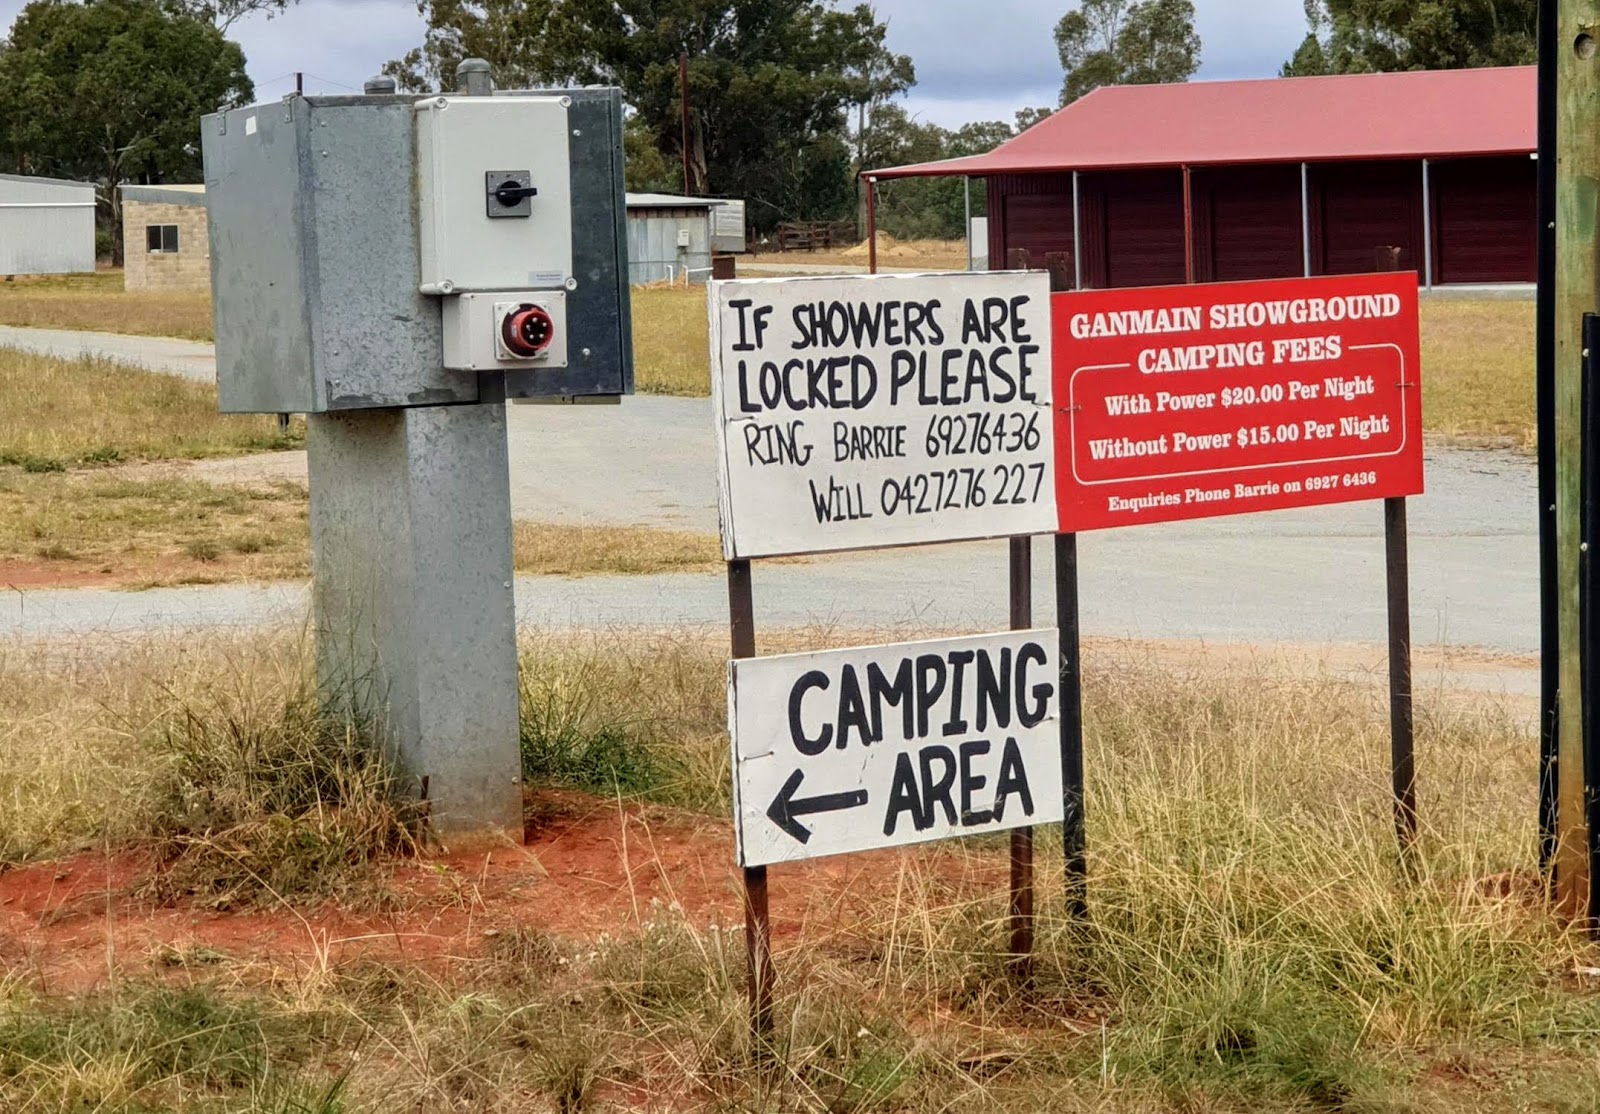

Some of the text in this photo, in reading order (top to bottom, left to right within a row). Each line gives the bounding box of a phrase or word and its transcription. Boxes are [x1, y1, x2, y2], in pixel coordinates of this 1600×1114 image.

[729, 296, 1031, 351] IF SHOWERS ARE
[1071, 294, 1400, 339] GANMAIN SHOWGROUND
[738, 345, 1039, 412] LOCKED PLEASE
[1138, 336, 1341, 374] CAMPING FEES
[1105, 376, 1374, 415] With Power $20.00 Per Night
[744, 412, 1039, 466] RING BARRIE 69276436
[1089, 415, 1389, 459] Without Power $15.00 Per Night
[809, 476, 872, 523] WILL
[1108, 471, 1376, 512] Enquiries Phone Barrie on 6927 6436
[789, 643, 1053, 755] CAMPING
[884, 738, 1033, 836] AREA
